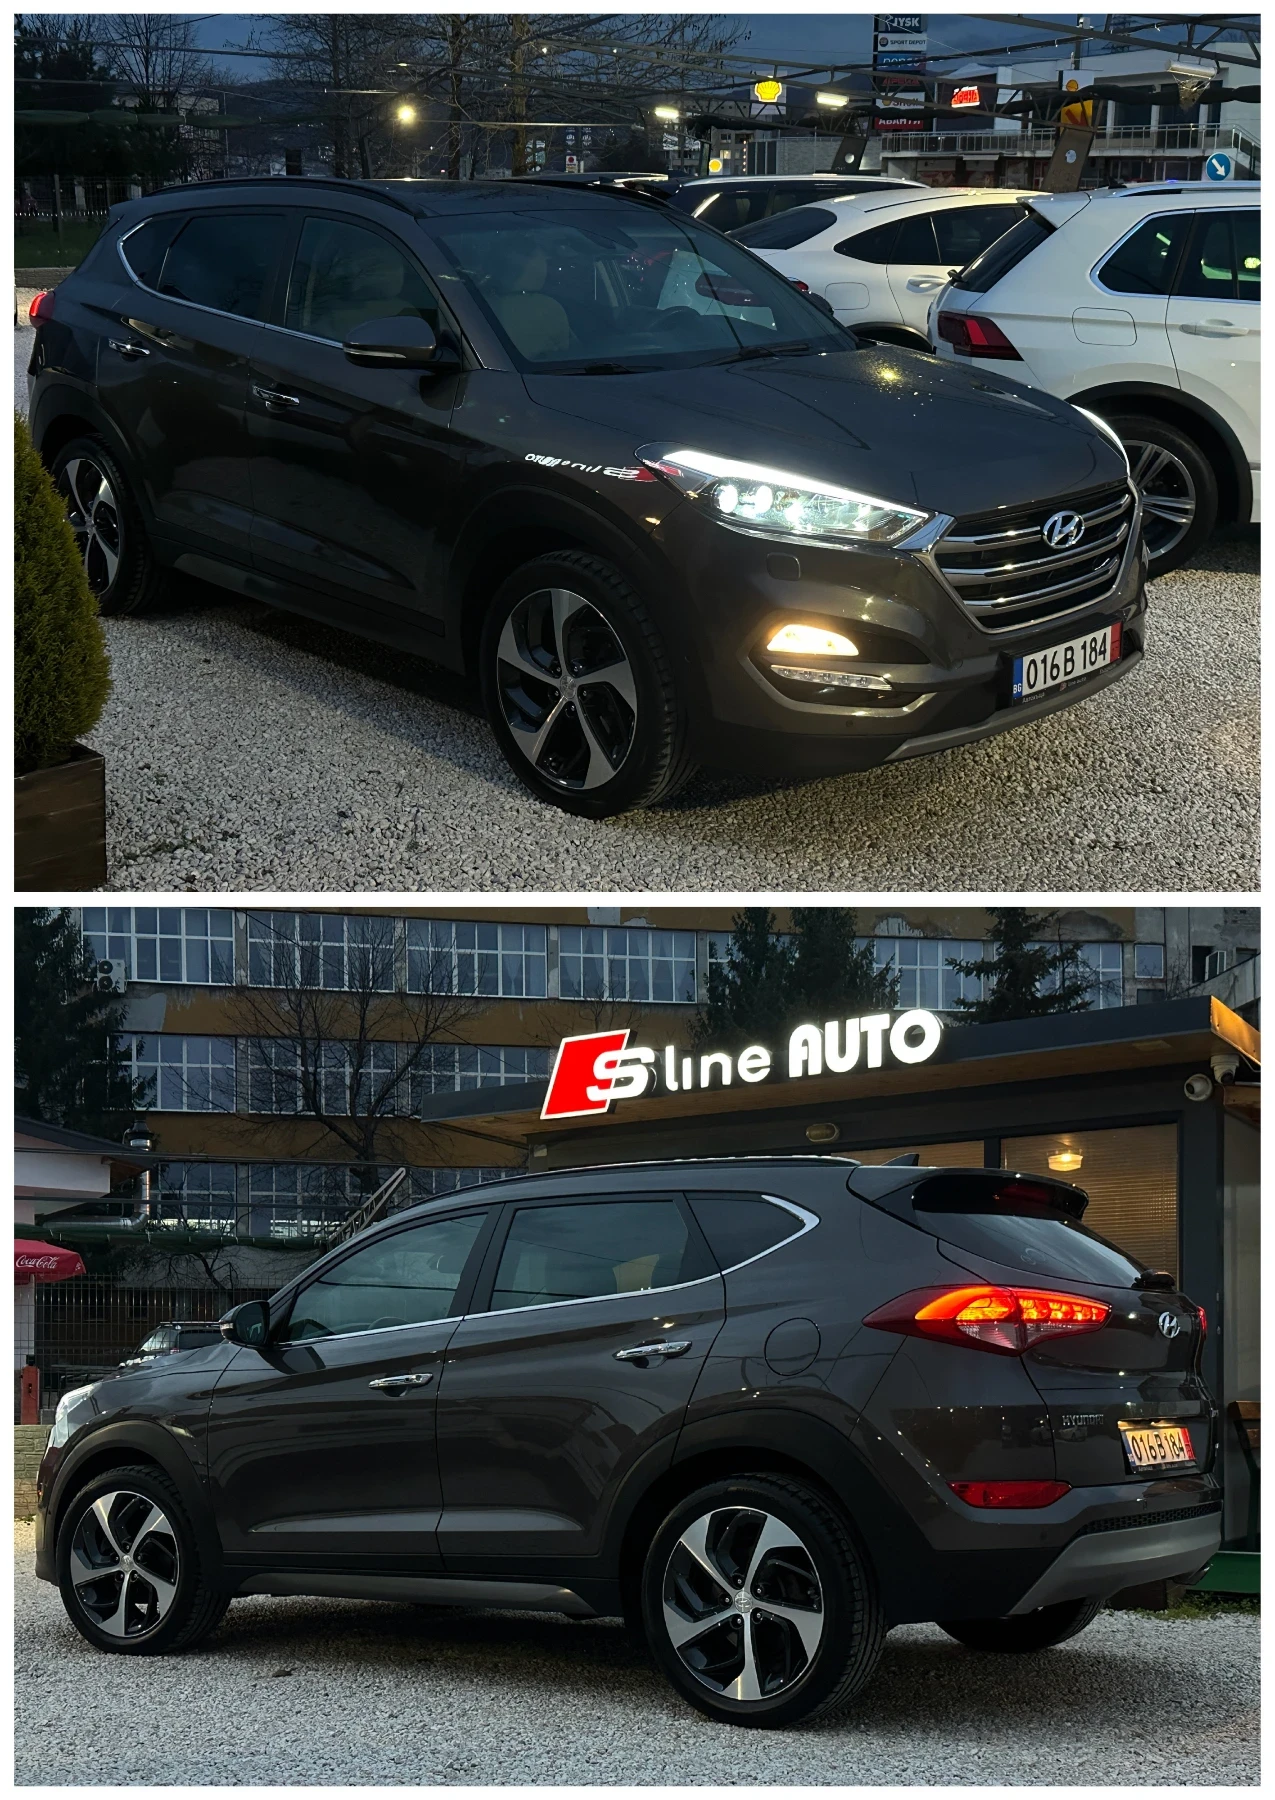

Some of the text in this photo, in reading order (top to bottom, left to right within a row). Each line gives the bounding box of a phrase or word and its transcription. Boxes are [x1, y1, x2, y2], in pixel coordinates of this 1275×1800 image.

[892, 17, 920, 27] JYSK
[1081, 631, 1107, 671] 184
[1013, 683, 1022, 694] BG
[788, 1008, 944, 1079] AUTO
[1062, 1414, 1104, 1426] HYUNDAI
[1164, 1431, 1186, 1460] 184
